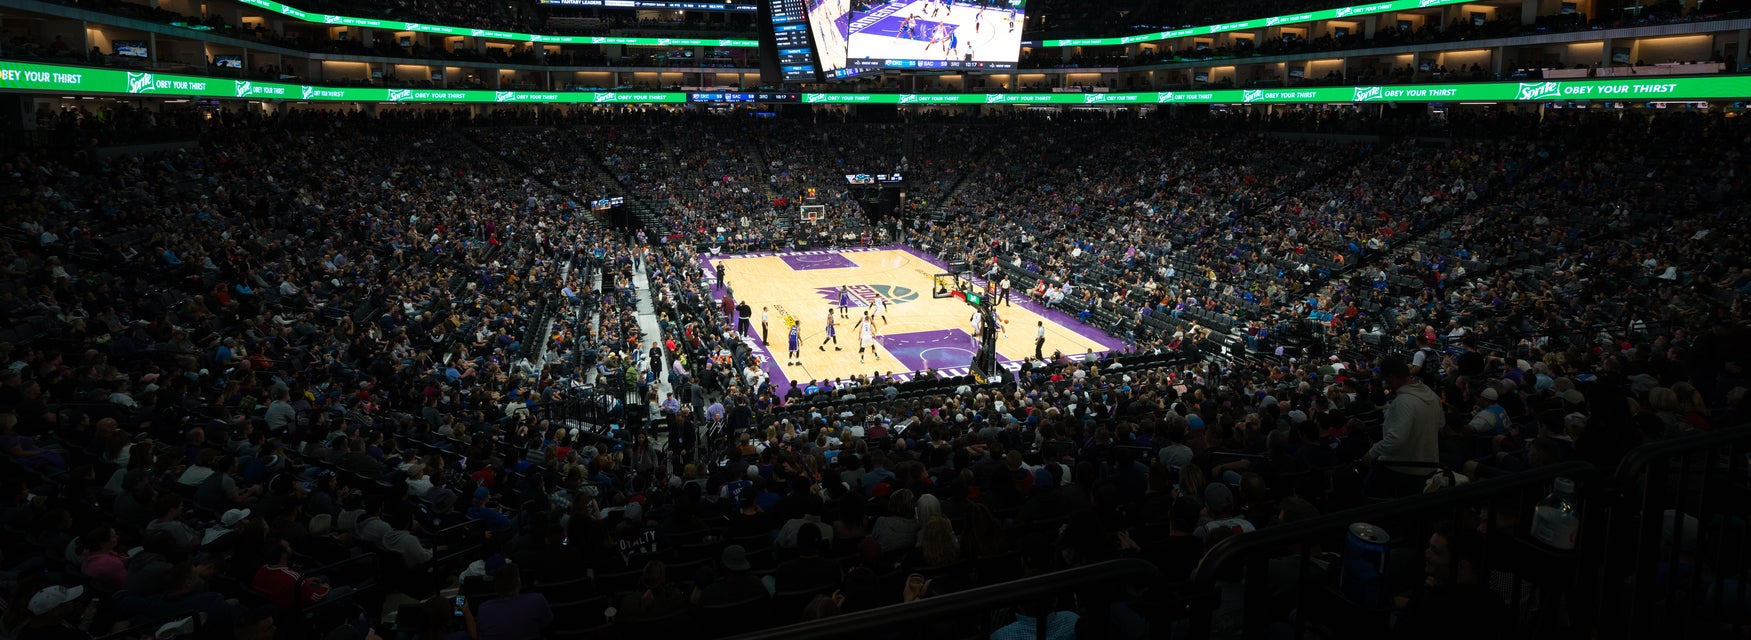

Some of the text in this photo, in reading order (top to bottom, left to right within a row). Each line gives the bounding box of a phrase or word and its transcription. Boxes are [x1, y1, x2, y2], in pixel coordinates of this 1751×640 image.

[0, 69, 82, 84] BEY YOUR THIRST
[129, 73, 152, 93] Sprite
[156, 80, 206, 91] OBEY YOUR THIRST
[1354, 87, 1381, 101] Sprite
[1518, 82, 1560, 100] Sprite
[1564, 84, 1678, 94] OBEY YOUR THIRST
[389, 89, 412, 101] Sprite
[497, 91, 514, 102] Sprite
[595, 92, 615, 102] Sprite
[808, 94, 826, 103] Sprite
[900, 94, 917, 103] Sprite
[987, 94, 1005, 103] Sprite
[1084, 93, 1104, 103] Sprite
[1158, 92, 1173, 103] Sprite
[1243, 90, 1262, 102] Sprite
